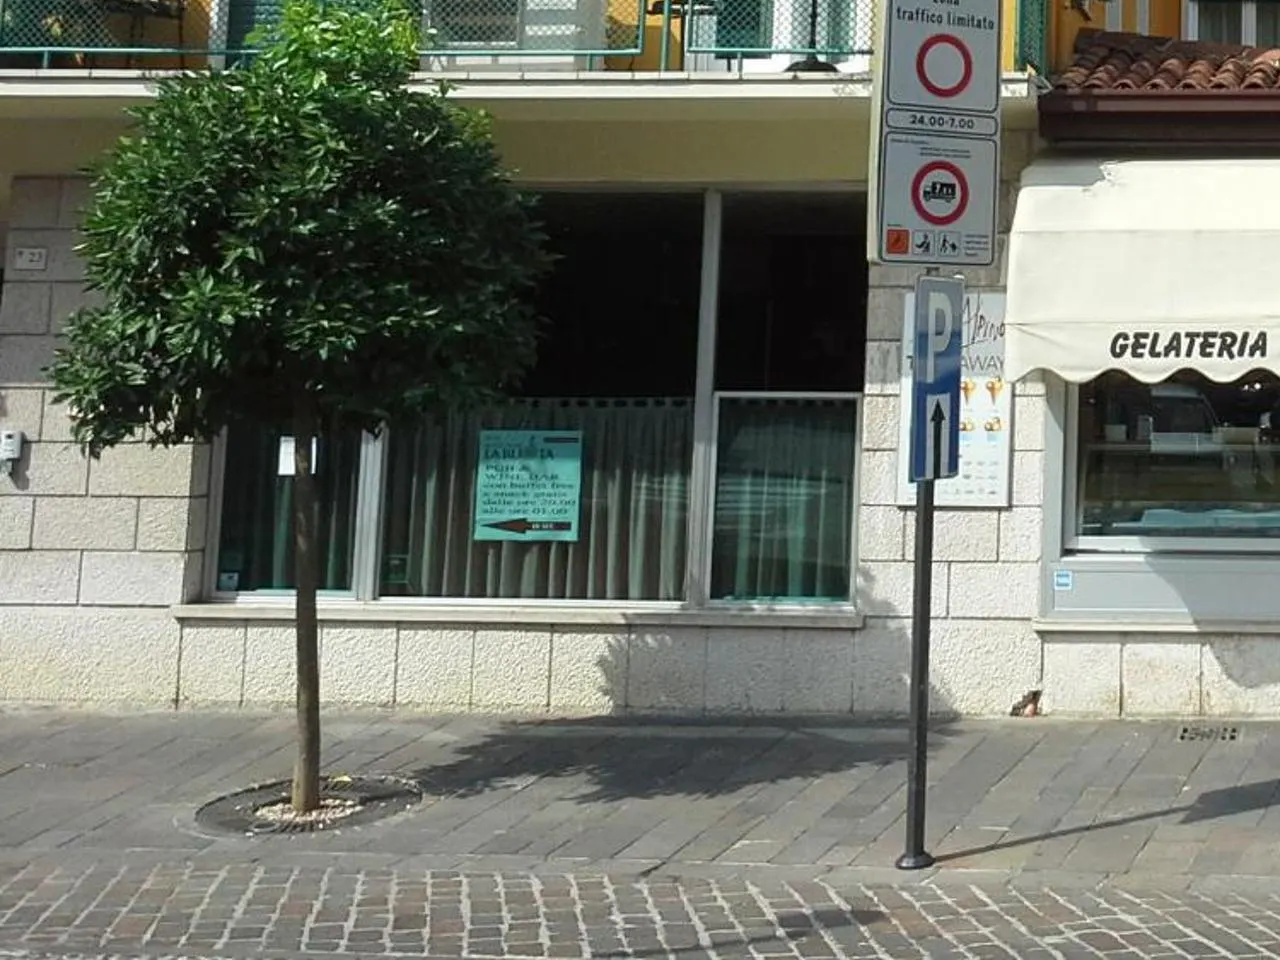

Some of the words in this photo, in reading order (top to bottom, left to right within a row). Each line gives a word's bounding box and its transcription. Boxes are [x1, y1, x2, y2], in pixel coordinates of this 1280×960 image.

[896, 6, 943, 25] traffico
[947, 11, 995, 31] limitato
[927, 291, 953, 383] P
[1110, 330, 1268, 361] GELATERIA
